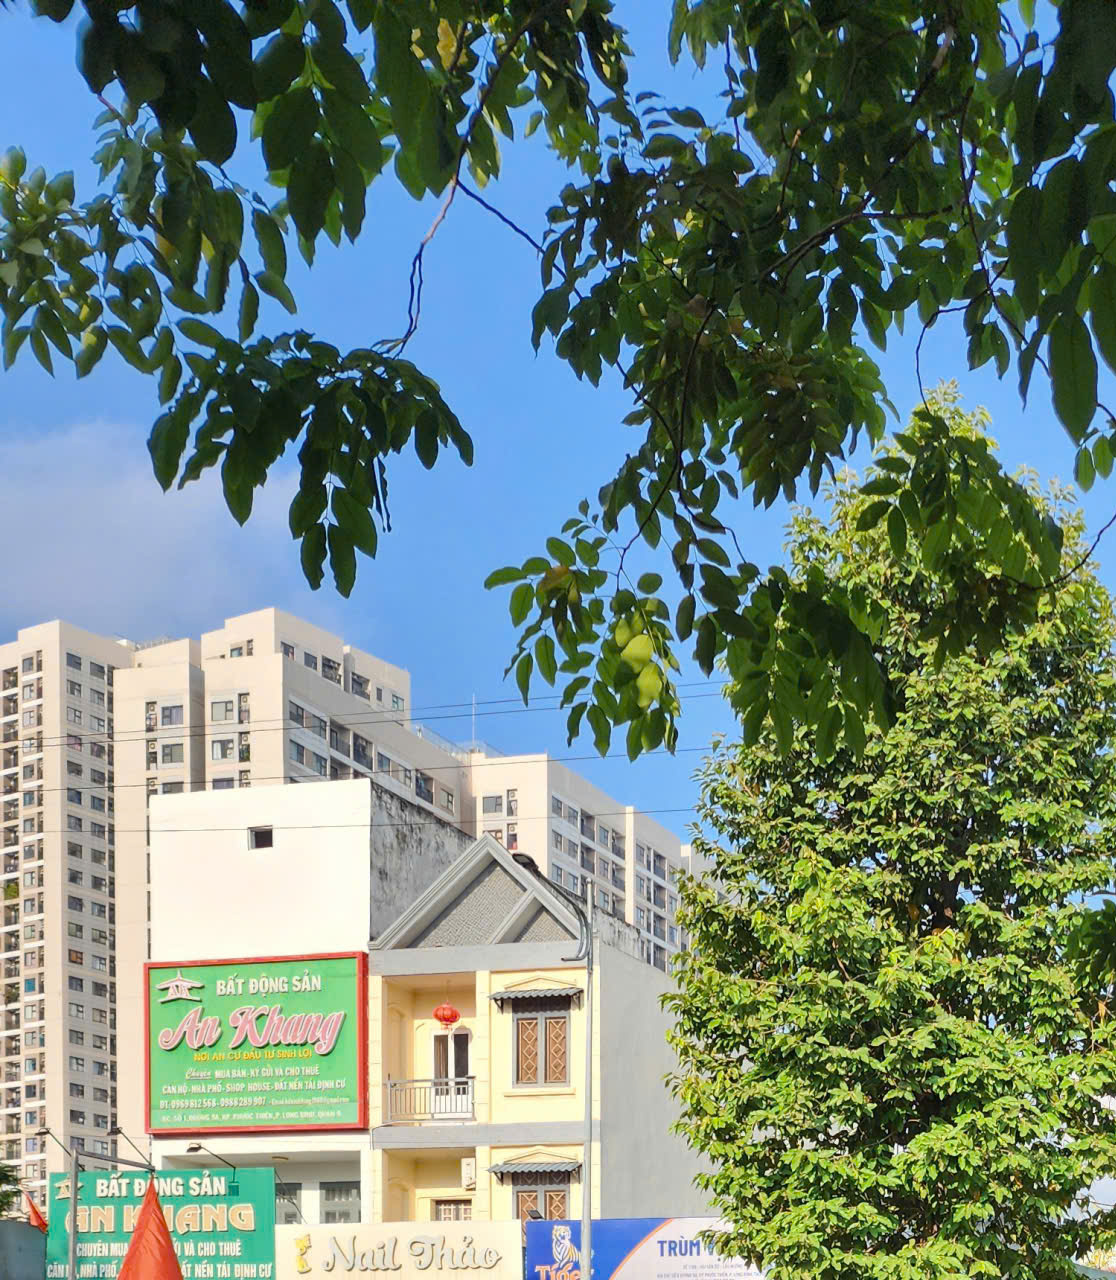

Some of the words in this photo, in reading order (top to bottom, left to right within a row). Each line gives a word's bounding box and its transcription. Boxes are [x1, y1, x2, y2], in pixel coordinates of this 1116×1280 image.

[216, 975, 244, 996] BẤT
[249, 975, 288, 998] ĐỘNG
[292, 969, 322, 991] SẢN
[158, 1006, 222, 1051] An
[229, 1004, 345, 1055] Khang
[226, 1083, 245, 1093] SHOP
[96, 1172, 130, 1197] BẤT
[188, 1170, 226, 1196] SẢN
[76, 1239, 108, 1257] CHUYÊN
[184, 1239, 195, 1257] VÀ
[198, 1241, 216, 1257] CHO
[218, 1238, 242, 1257] THUÊ
[322, 1235, 402, 1272] Nail
[409, 1234, 503, 1270] Thảo
[657, 1236, 701, 1257] TRÙM
[80, 1260, 98, 1278] NHÀ
[181, 1260, 192, 1278] ẤT
[194, 1259, 214, 1278] NỀN
[216, 1261, 231, 1278] TÁI
[259, 1262, 273, 1278] CƯ
